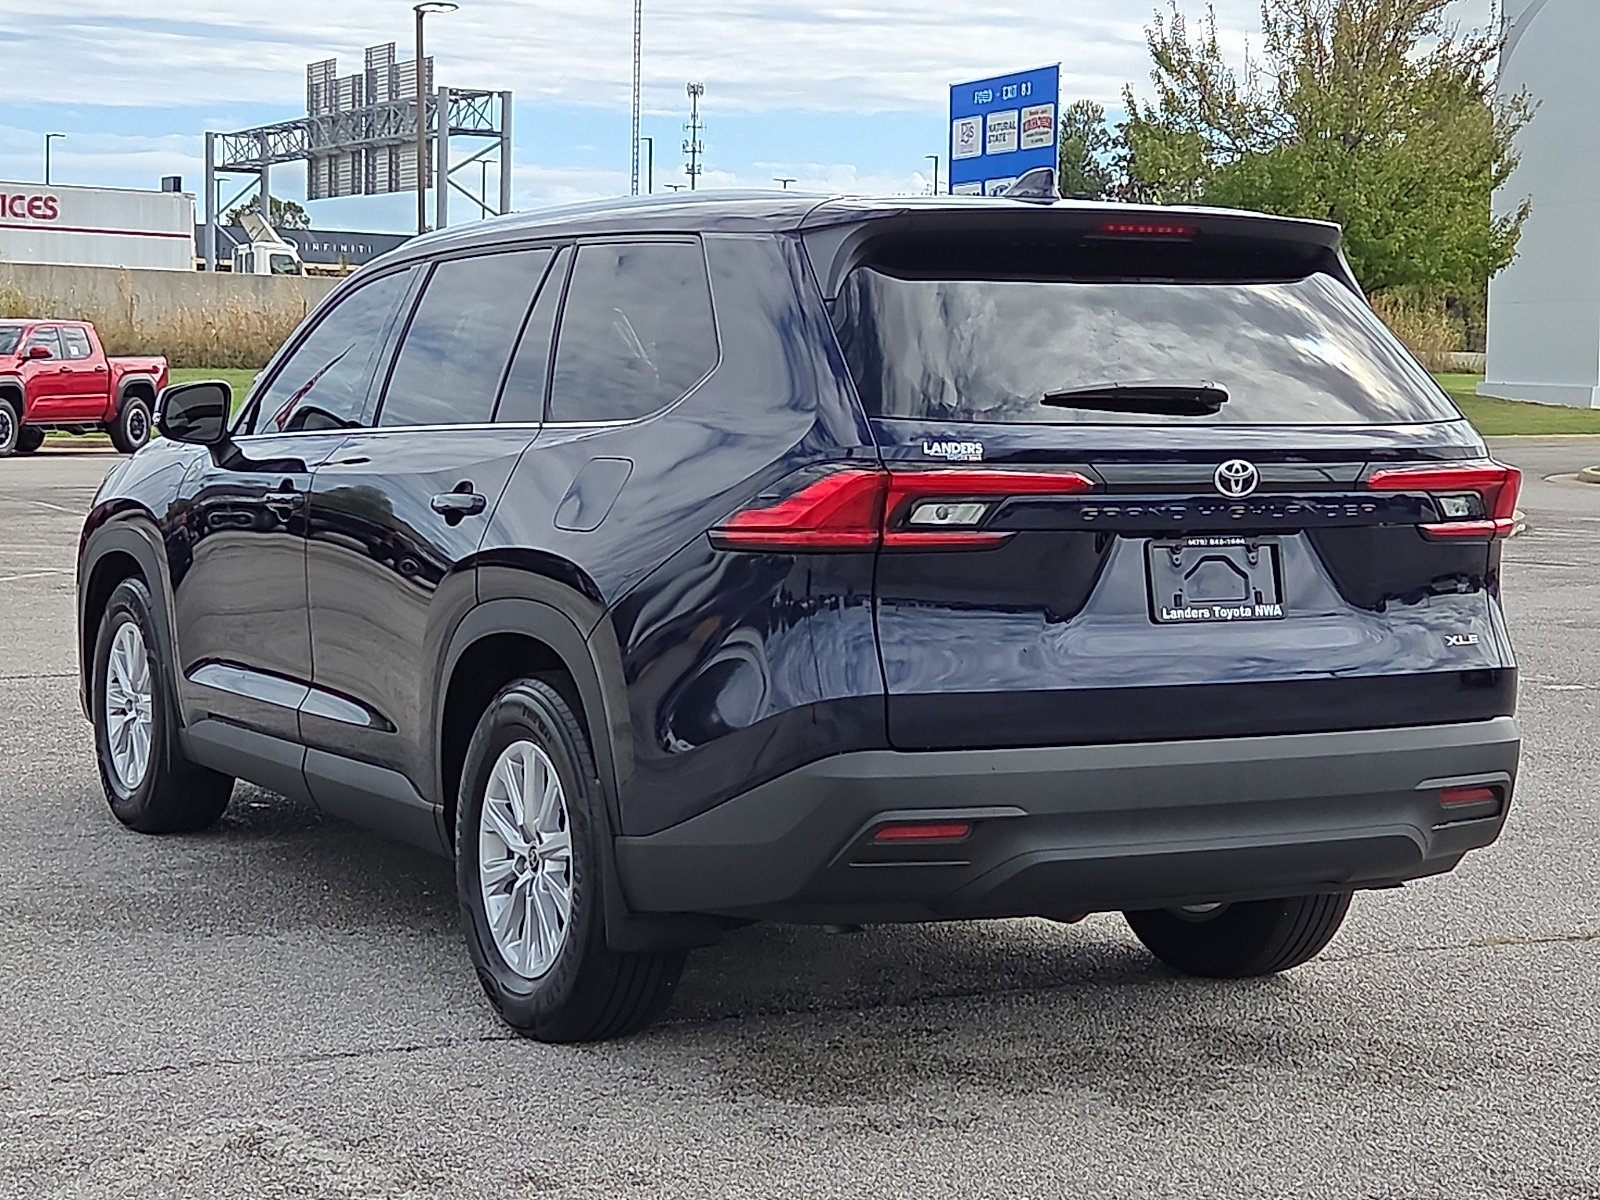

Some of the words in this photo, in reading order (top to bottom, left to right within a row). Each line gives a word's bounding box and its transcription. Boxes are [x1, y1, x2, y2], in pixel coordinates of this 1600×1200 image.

[1002, 84, 1017, 100] EXIT
[988, 120, 1017, 133] NATURAL
[988, 132, 1007, 144] STATE
[0, 194, 58, 220] ICES
[304, 241, 373, 254] INFINITI
[923, 441, 984, 454] LANDERS
[1079, 505, 1188, 521] GRAND
[1198, 503, 1377, 520] HIGHLANDER
[1162, 607, 1211, 619] Landers
[1213, 605, 1252, 620] Toyota
[1255, 604, 1283, 616] NWA
[1444, 634, 1479, 647] XLE
